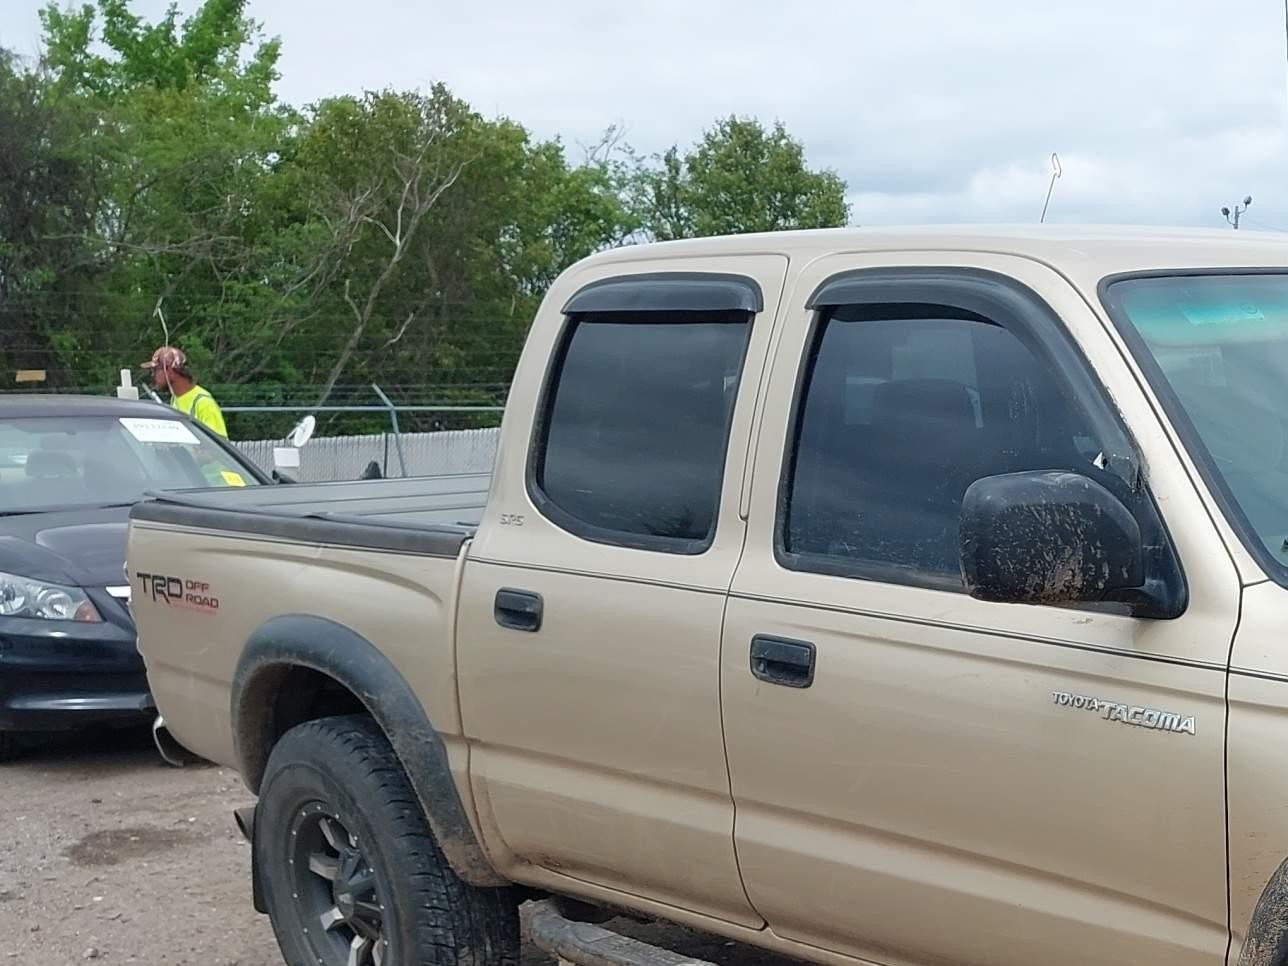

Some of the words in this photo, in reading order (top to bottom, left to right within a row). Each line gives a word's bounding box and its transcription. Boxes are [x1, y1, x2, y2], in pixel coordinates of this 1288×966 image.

[137, 572, 183, 604] TRD
[185, 579, 210, 592] OFF
[185, 593, 219, 608] ROAD
[1052, 691, 1099, 711] TOYOTA
[1100, 701, 1196, 735] TACOMA
